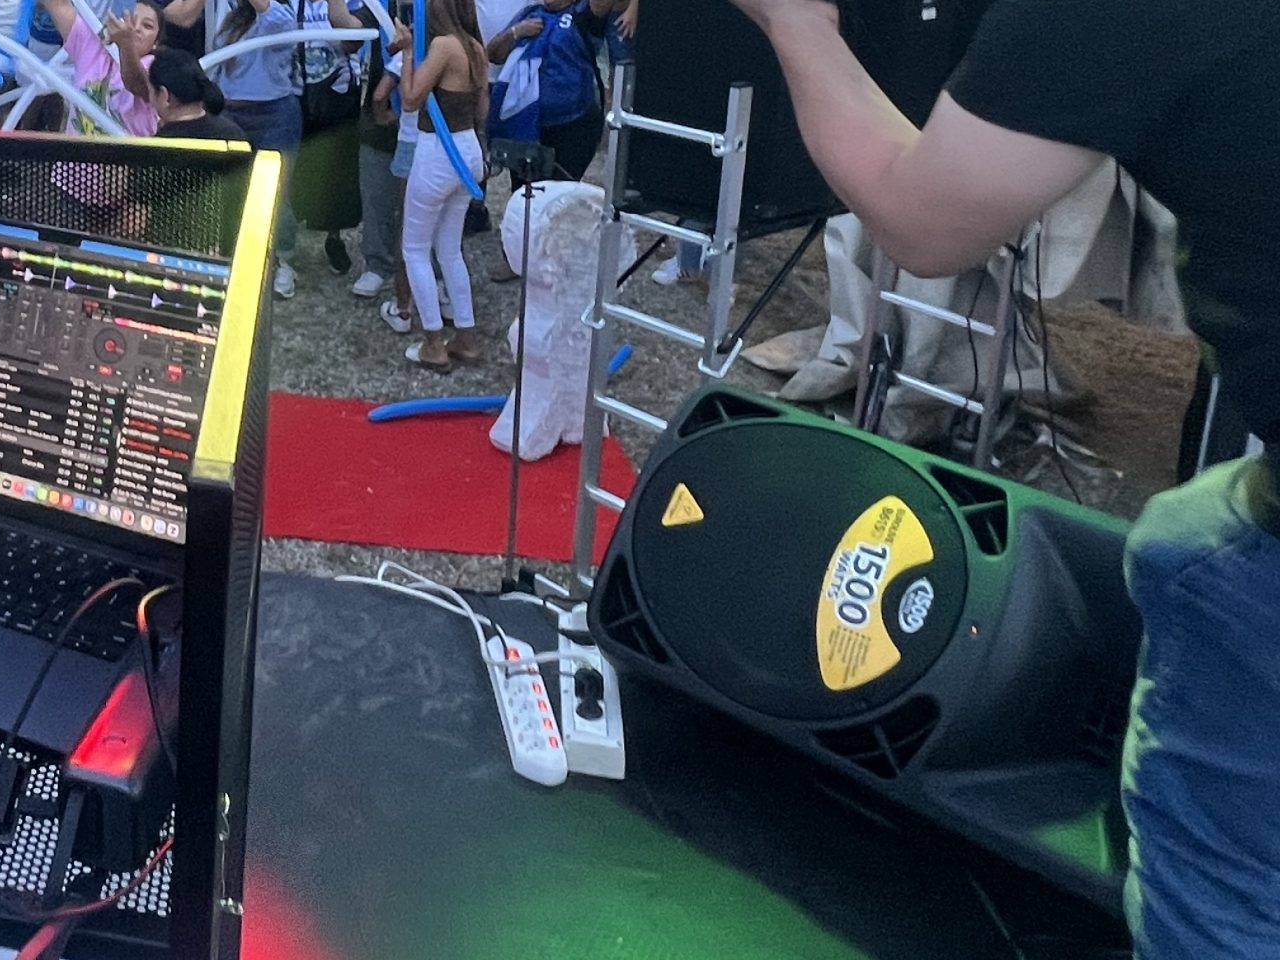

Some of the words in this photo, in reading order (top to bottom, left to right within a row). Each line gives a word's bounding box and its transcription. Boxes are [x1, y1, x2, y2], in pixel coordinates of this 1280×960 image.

[827, 551, 851, 598] WATTS
[838, 545, 888, 624] 1500
[908, 587, 934, 629] 1500
